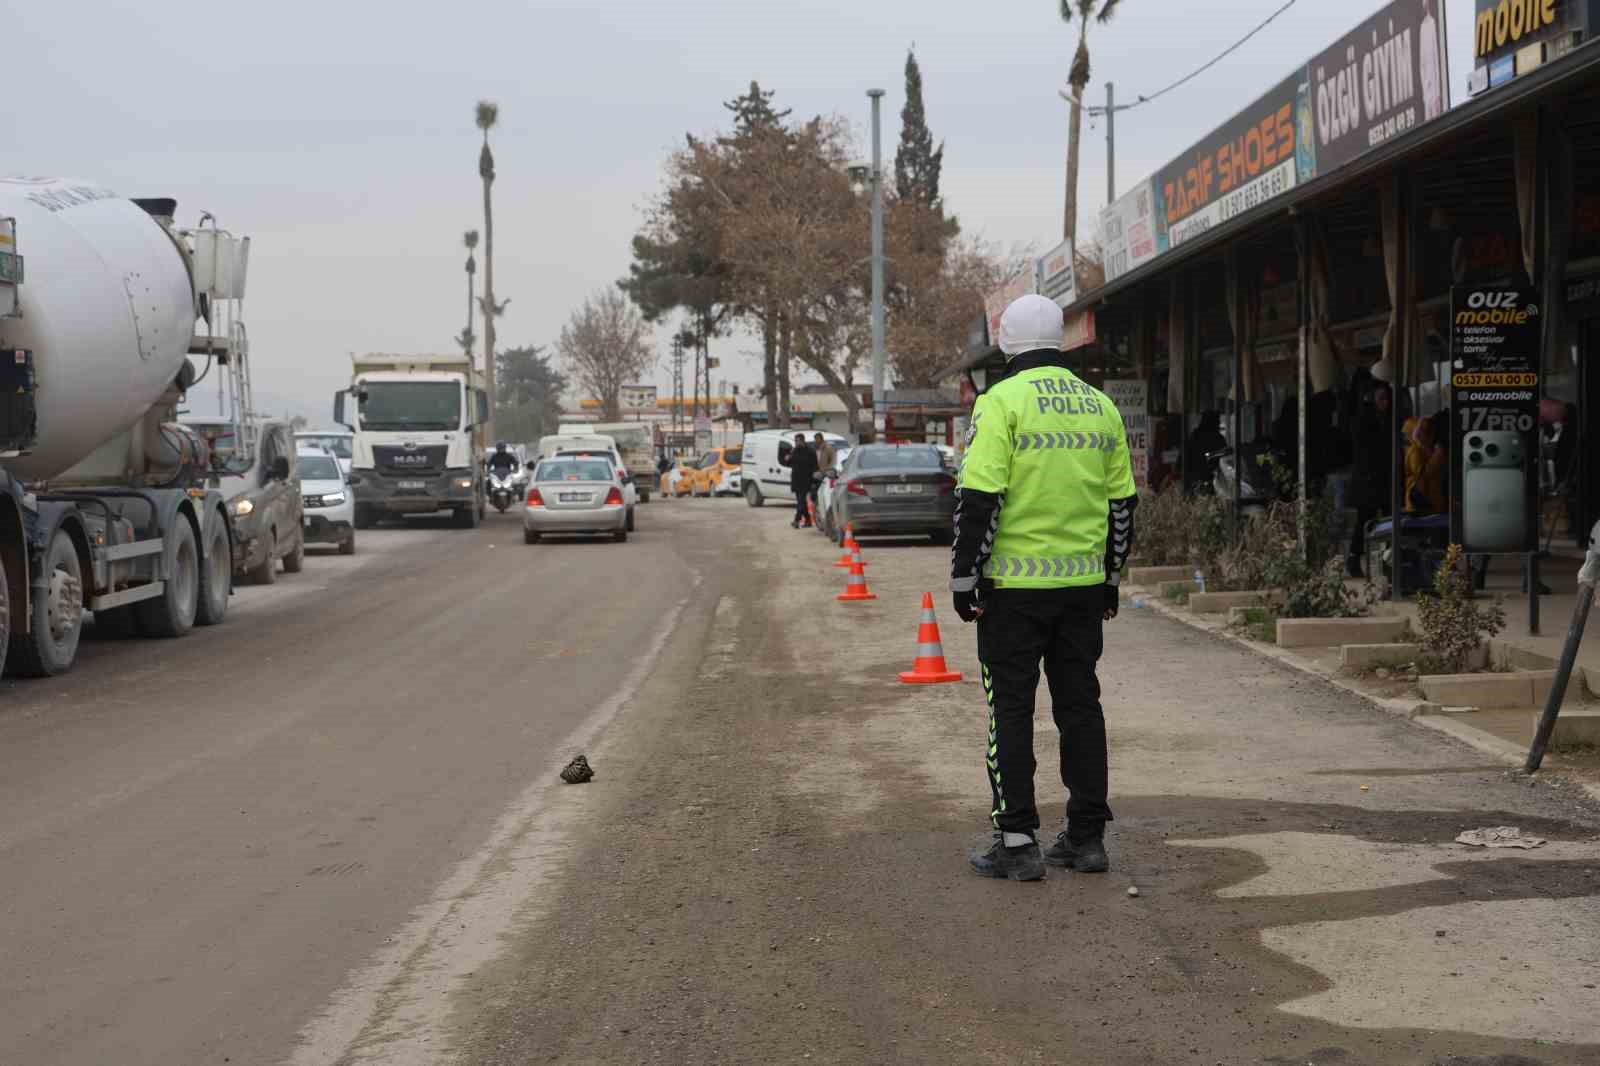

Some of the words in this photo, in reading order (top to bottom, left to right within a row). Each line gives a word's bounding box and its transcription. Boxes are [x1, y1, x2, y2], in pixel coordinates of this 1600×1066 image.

[1317, 45, 1360, 146] ÖZGÜ
[1362, 19, 1414, 120] GİYİM
[1216, 102, 1295, 193] SHOES
[1455, 308, 1528, 325] mobile
[1456, 375, 1482, 385] 0537
[1470, 391, 1534, 401] ouzmobile
[1037, 396, 1104, 417] POLİSİ
[1459, 407, 1488, 431] 17
[1487, 414, 1534, 431] PRO
[393, 455, 427, 464] MAN
